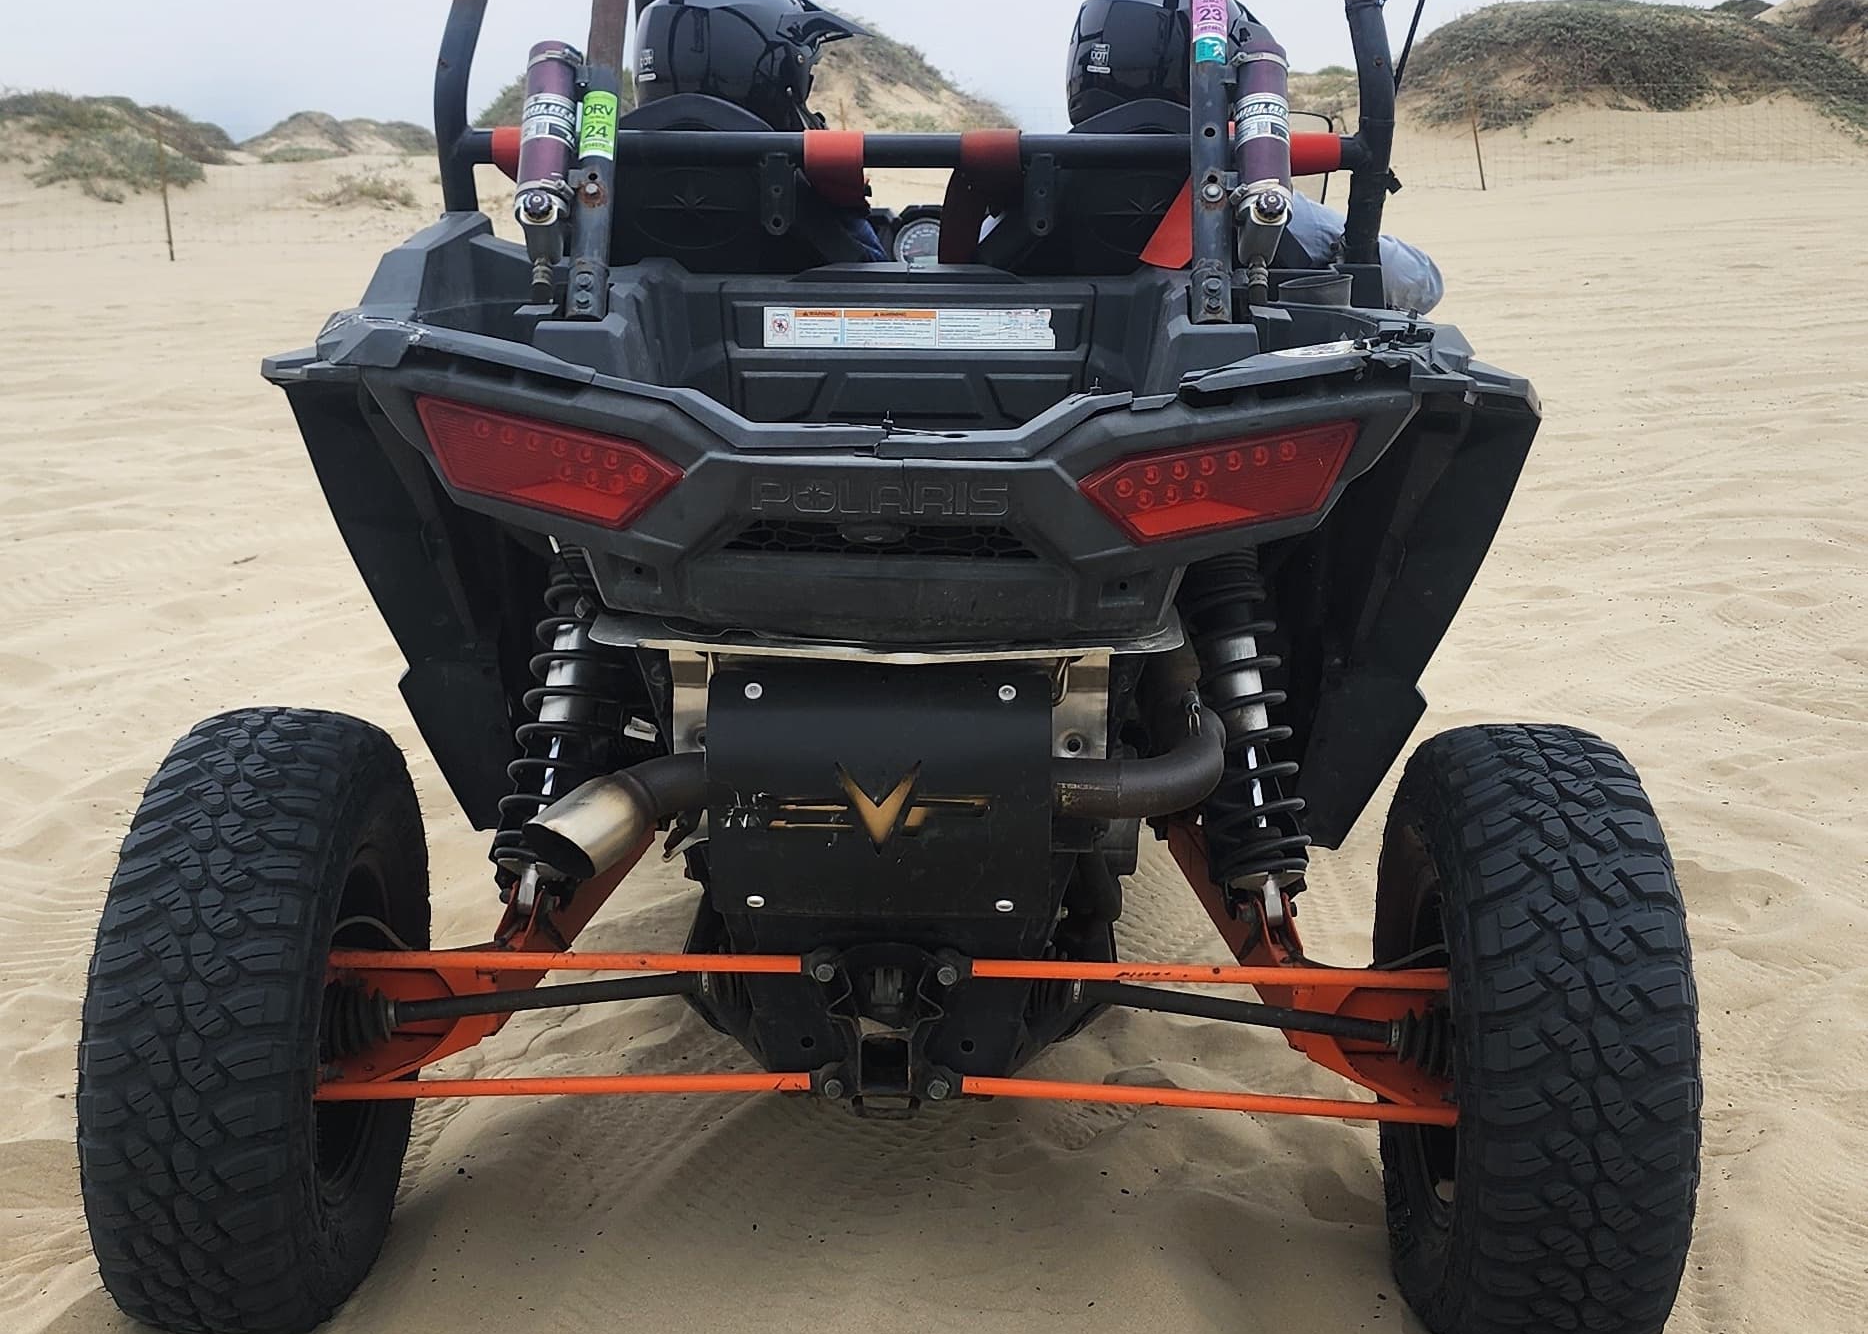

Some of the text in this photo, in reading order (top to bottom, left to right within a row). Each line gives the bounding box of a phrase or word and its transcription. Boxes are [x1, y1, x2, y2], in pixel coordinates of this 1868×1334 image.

[1200, 8, 1222, 22] 23
[583, 103, 614, 117] ORV
[585, 125, 609, 139] 24
[751, 478, 1009, 516] POLARIS
